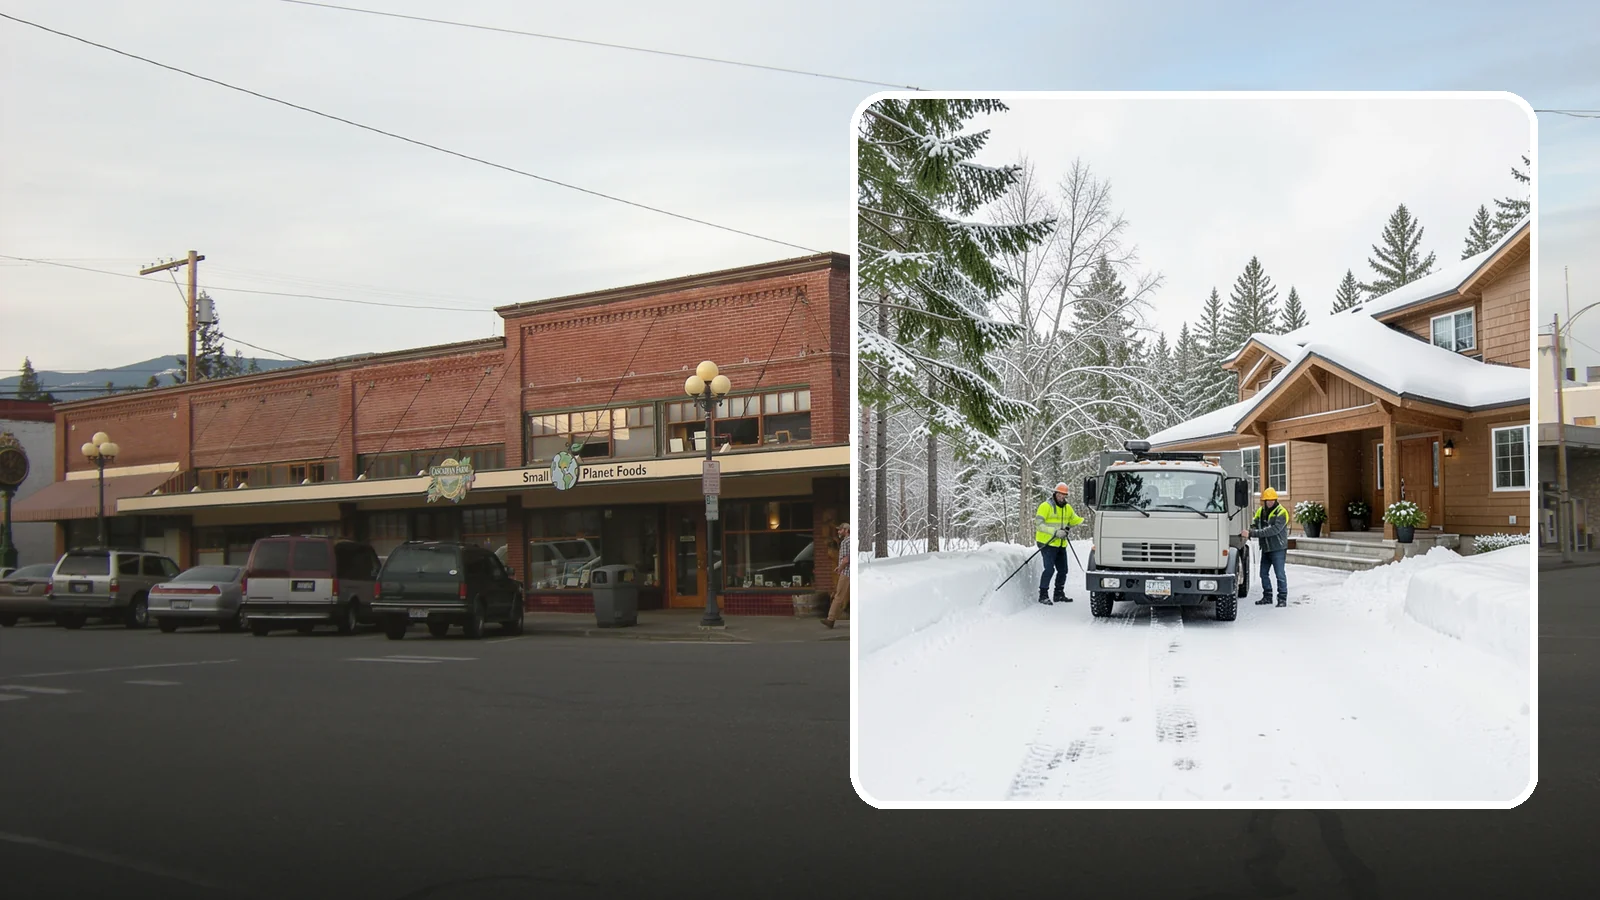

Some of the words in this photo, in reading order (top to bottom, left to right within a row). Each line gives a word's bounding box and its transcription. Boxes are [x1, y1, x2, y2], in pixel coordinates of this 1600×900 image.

[523, 471, 548, 483] Small
[583, 468, 614, 479] Planet
[617, 464, 647, 476] Foods
